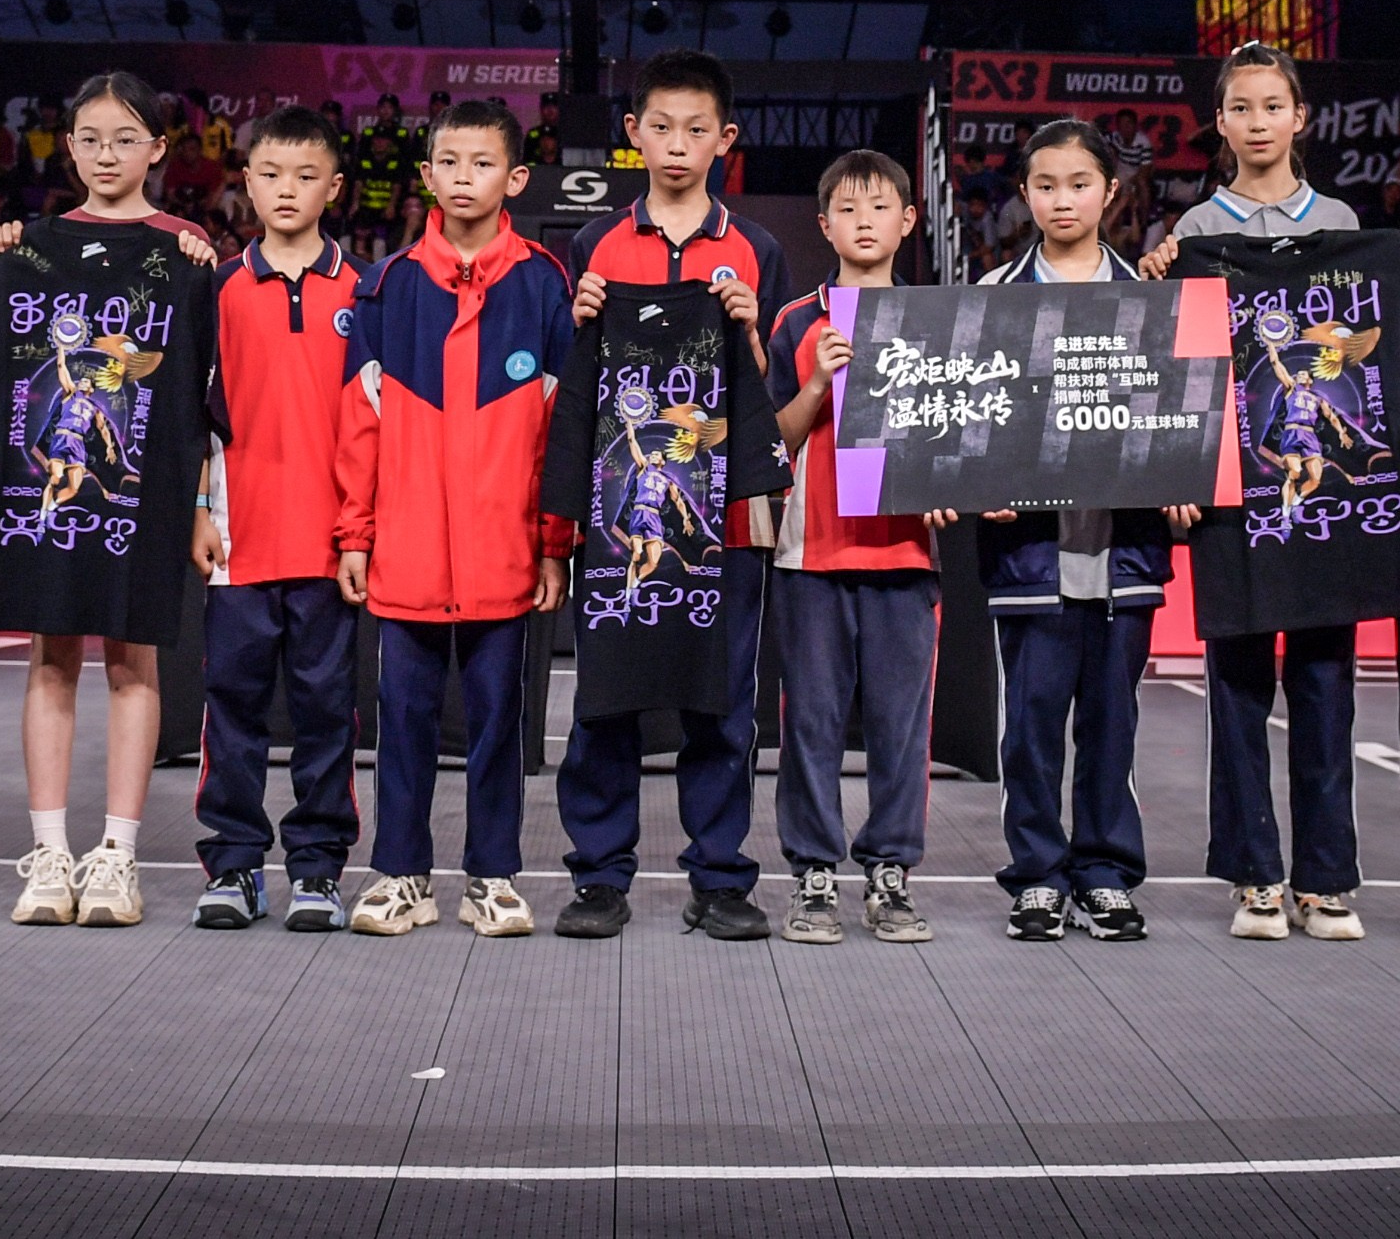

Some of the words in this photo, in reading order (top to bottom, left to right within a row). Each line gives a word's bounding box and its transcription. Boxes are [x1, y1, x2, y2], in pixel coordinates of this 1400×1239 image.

[474, 64, 559, 85] SERIES
[1065, 72, 1149, 94] WORLD
[1053, 355, 1148, 372] 向成都市体育局
[1054, 389, 1110, 404] 捐赠价值
[887, 386, 1013, 442] 温情永传
[1055, 404, 1200, 432] 6000元篮球物资
[2, 486, 42, 497] 2020
[585, 566, 627, 580] 2020
